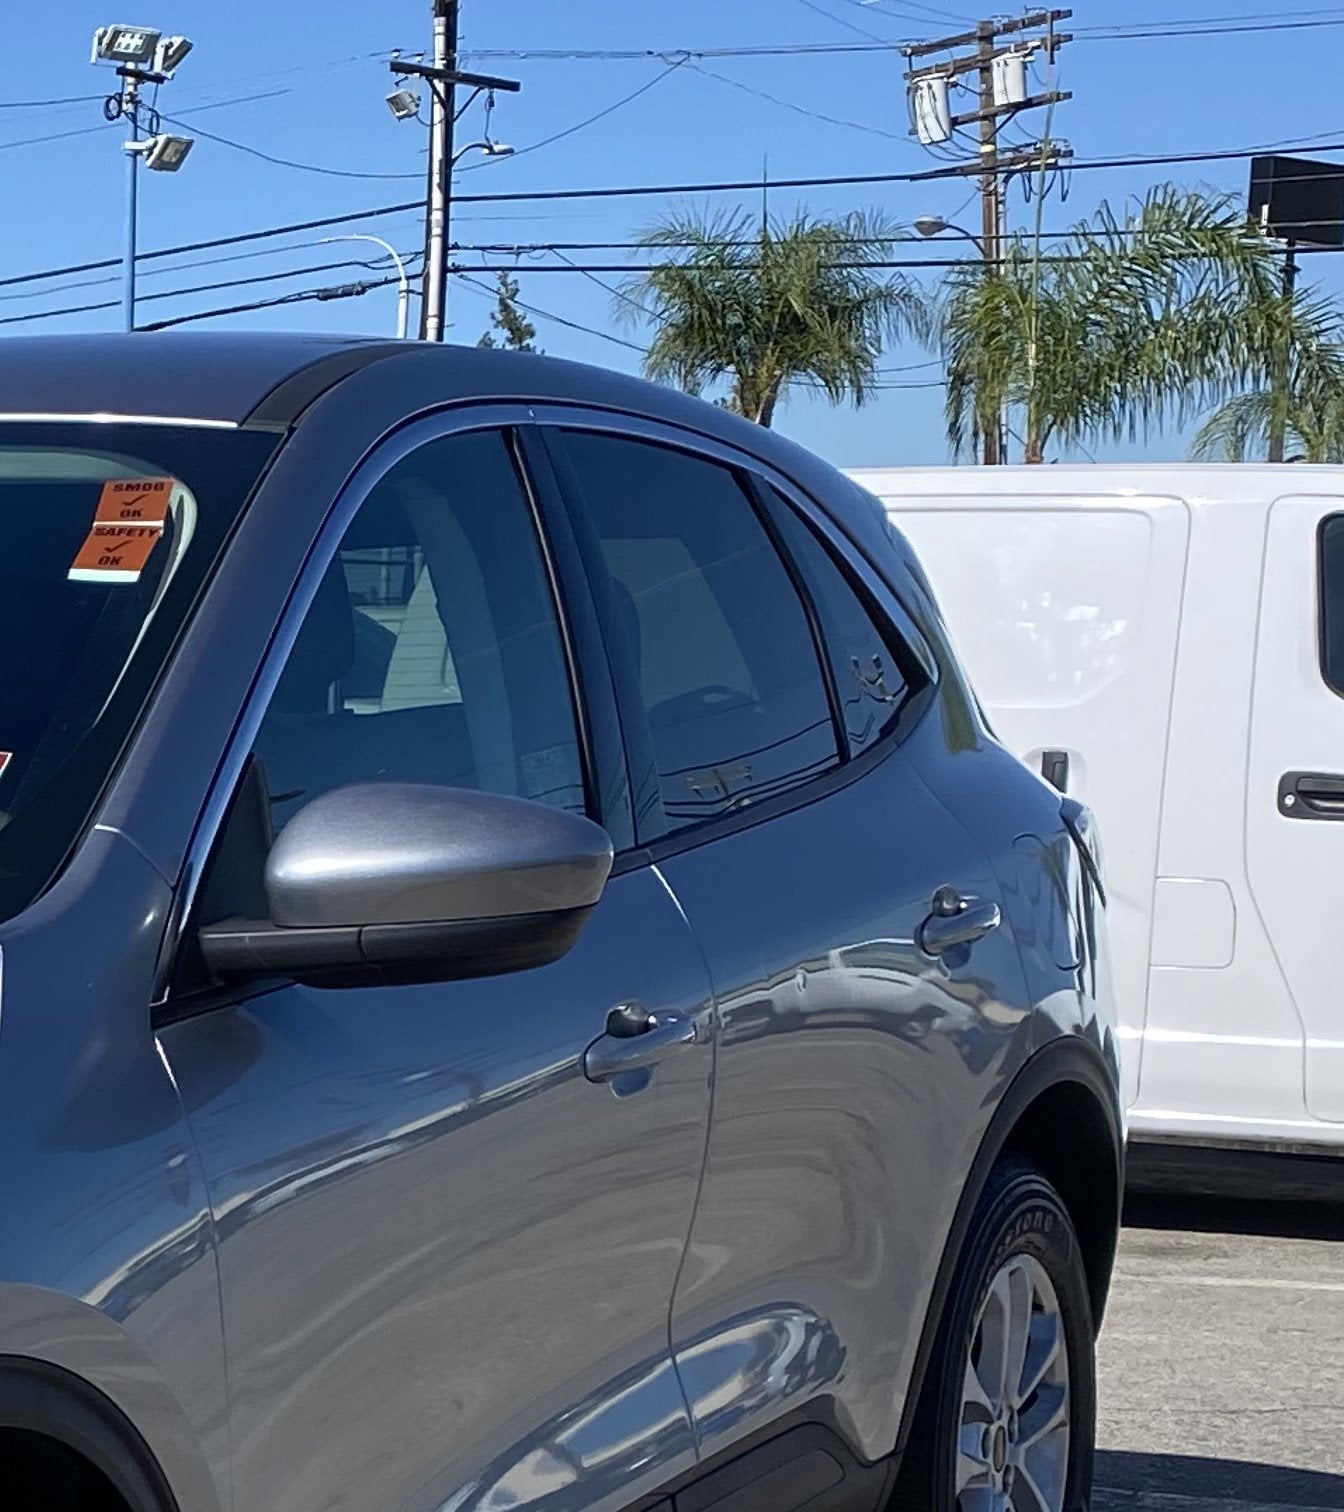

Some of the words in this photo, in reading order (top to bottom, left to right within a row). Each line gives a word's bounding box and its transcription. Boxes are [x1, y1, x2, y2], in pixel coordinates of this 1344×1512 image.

[112, 482, 165, 492] SMOG
[120, 508, 144, 518] OK
[94, 527, 159, 538] SAFETY
[97, 555, 124, 566] OK
